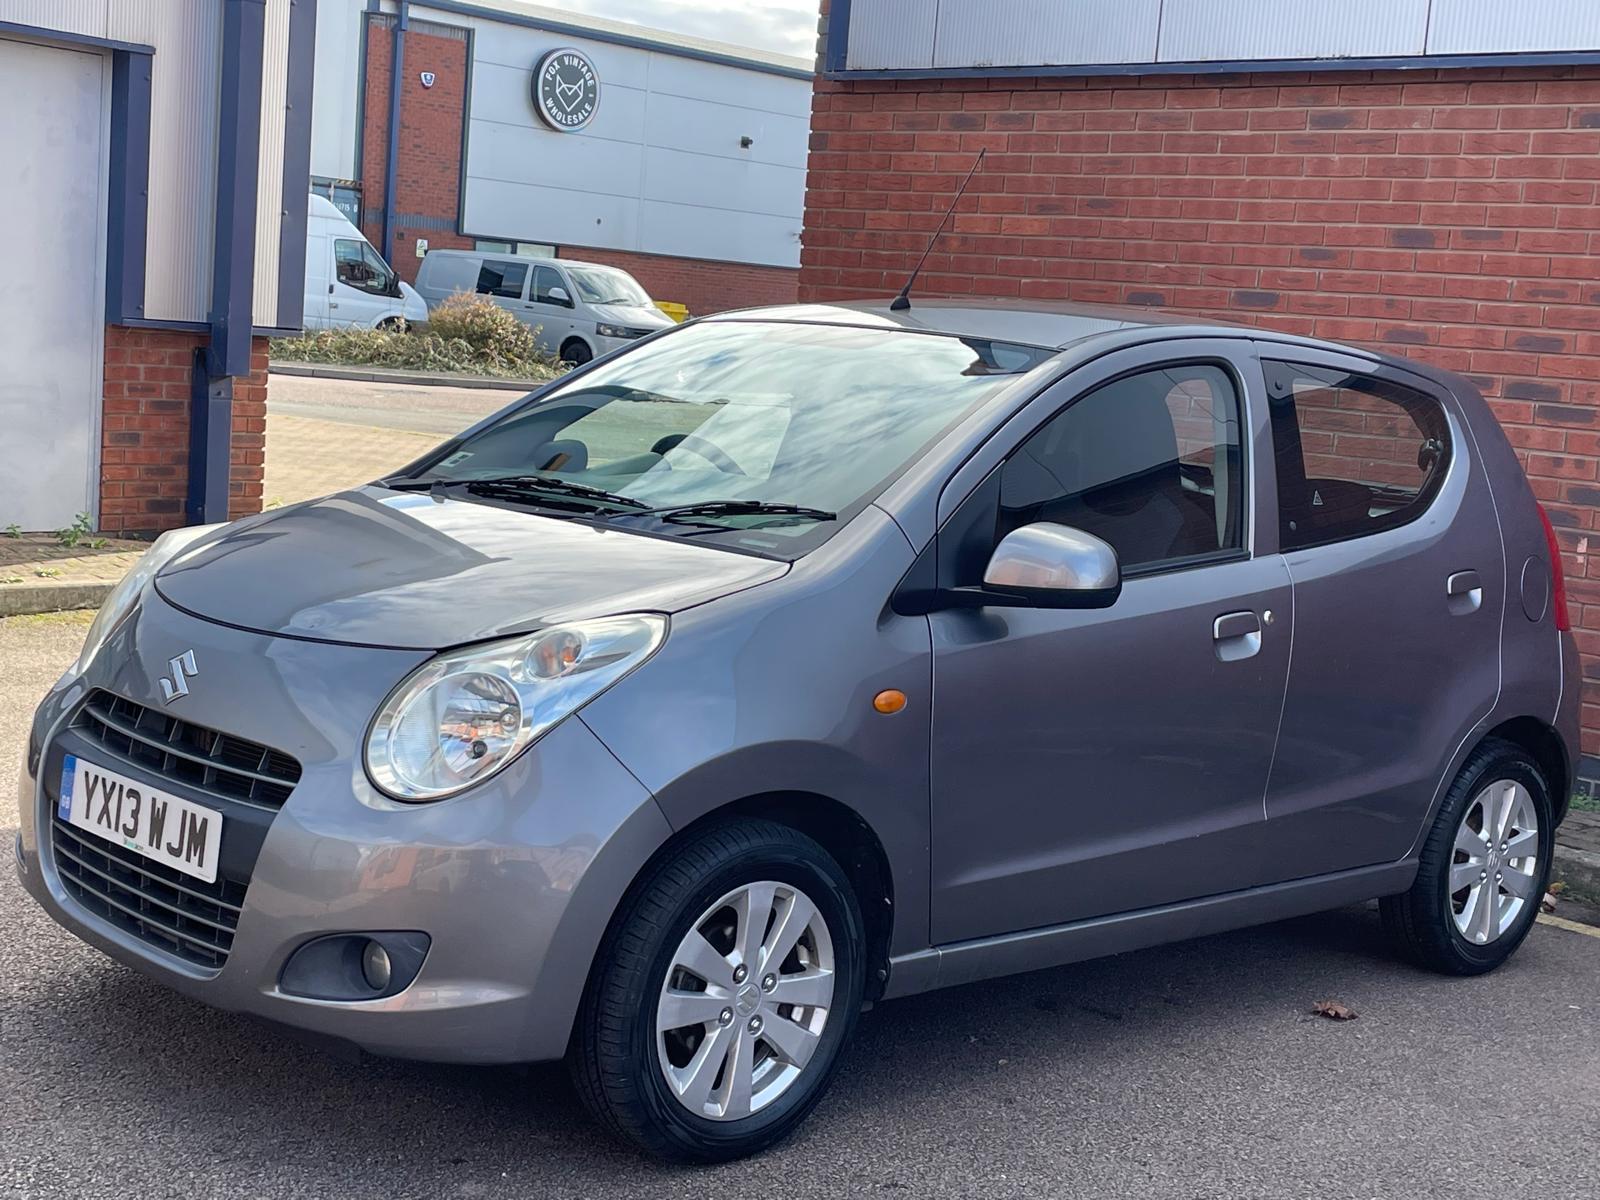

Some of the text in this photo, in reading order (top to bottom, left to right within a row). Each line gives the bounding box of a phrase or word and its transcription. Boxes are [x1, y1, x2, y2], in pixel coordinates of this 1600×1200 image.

[545, 55, 595, 87] FOX VINTAGE
[545, 97, 592, 125] WHOLESALE
[84, 770, 209, 868] YX13 WJM
